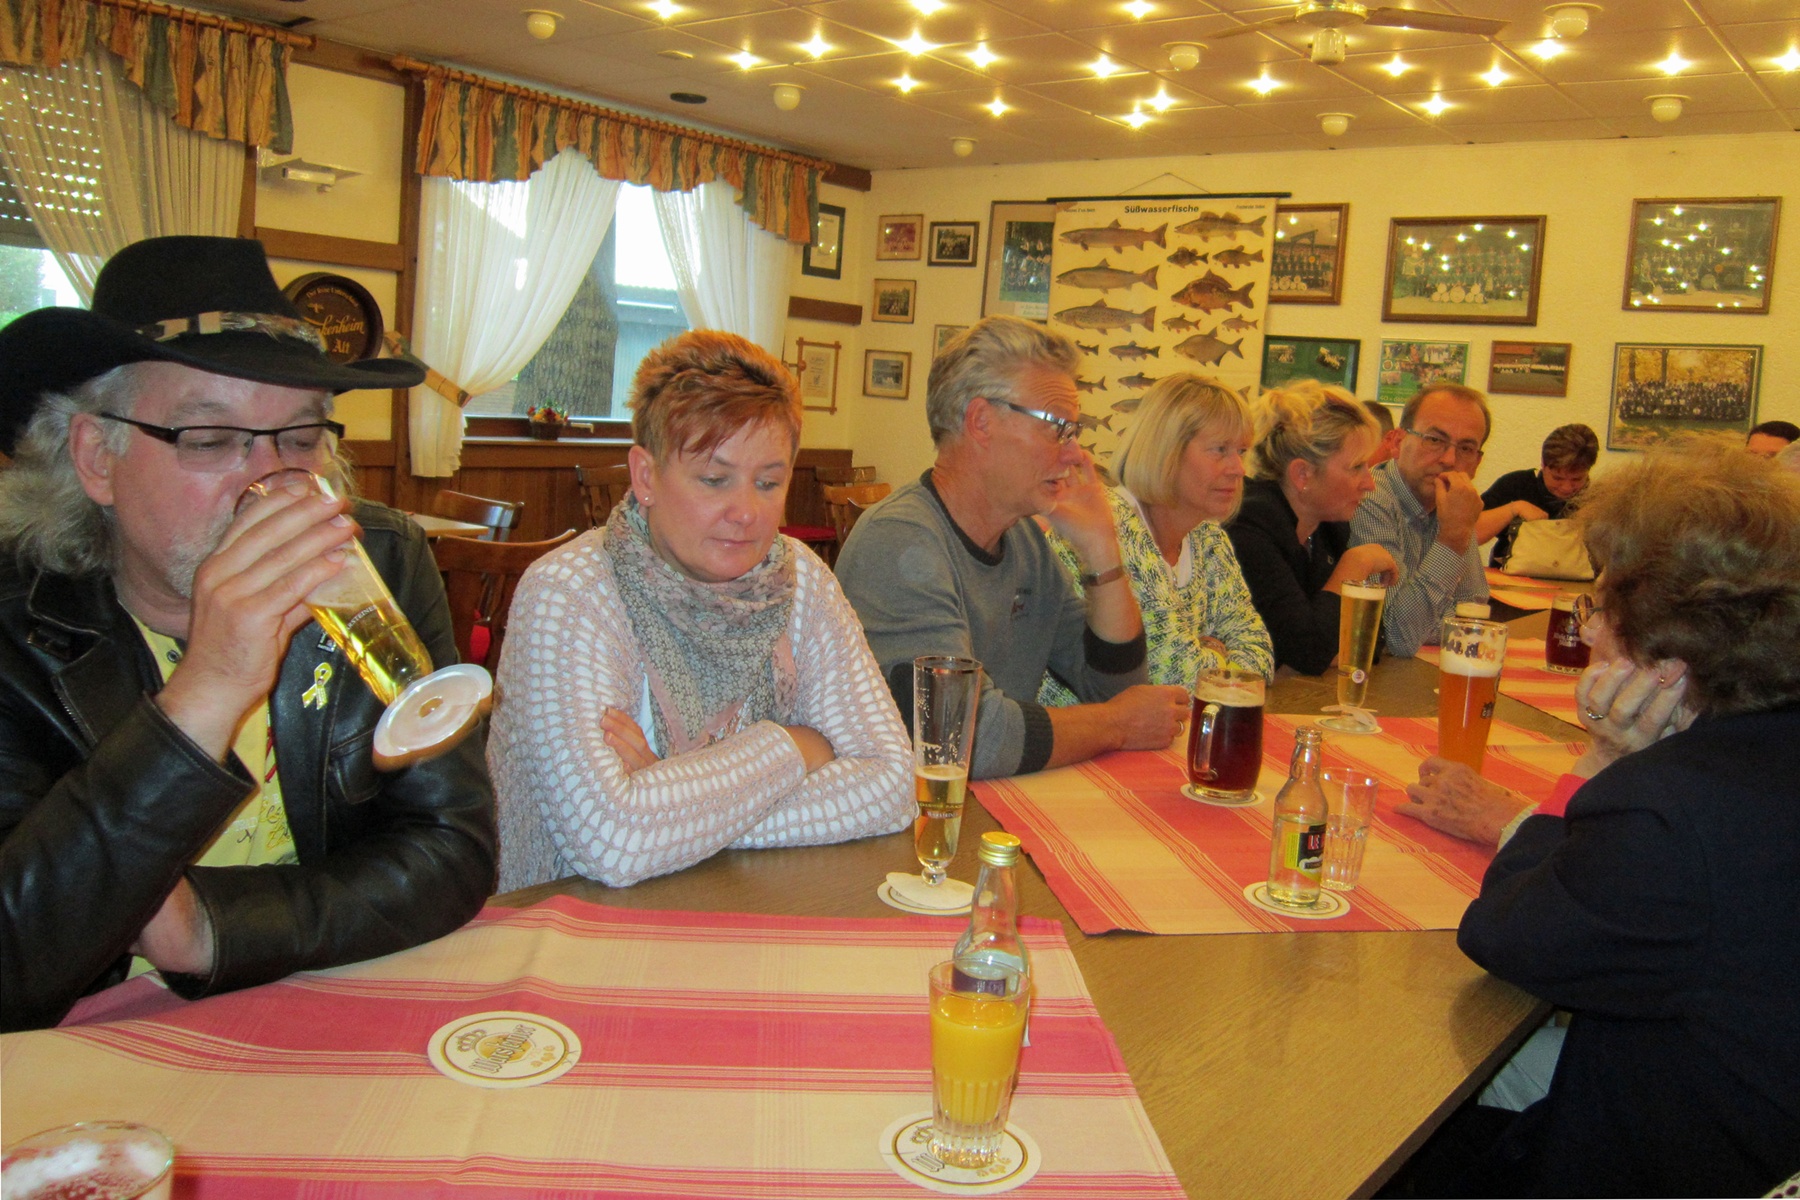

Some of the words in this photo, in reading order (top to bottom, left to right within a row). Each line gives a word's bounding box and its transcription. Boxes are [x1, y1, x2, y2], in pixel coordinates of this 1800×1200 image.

[1124, 204, 1199, 213] Süßwasserfische
[316, 314, 365, 335] kenheim
[332, 339, 350, 354] Alt
